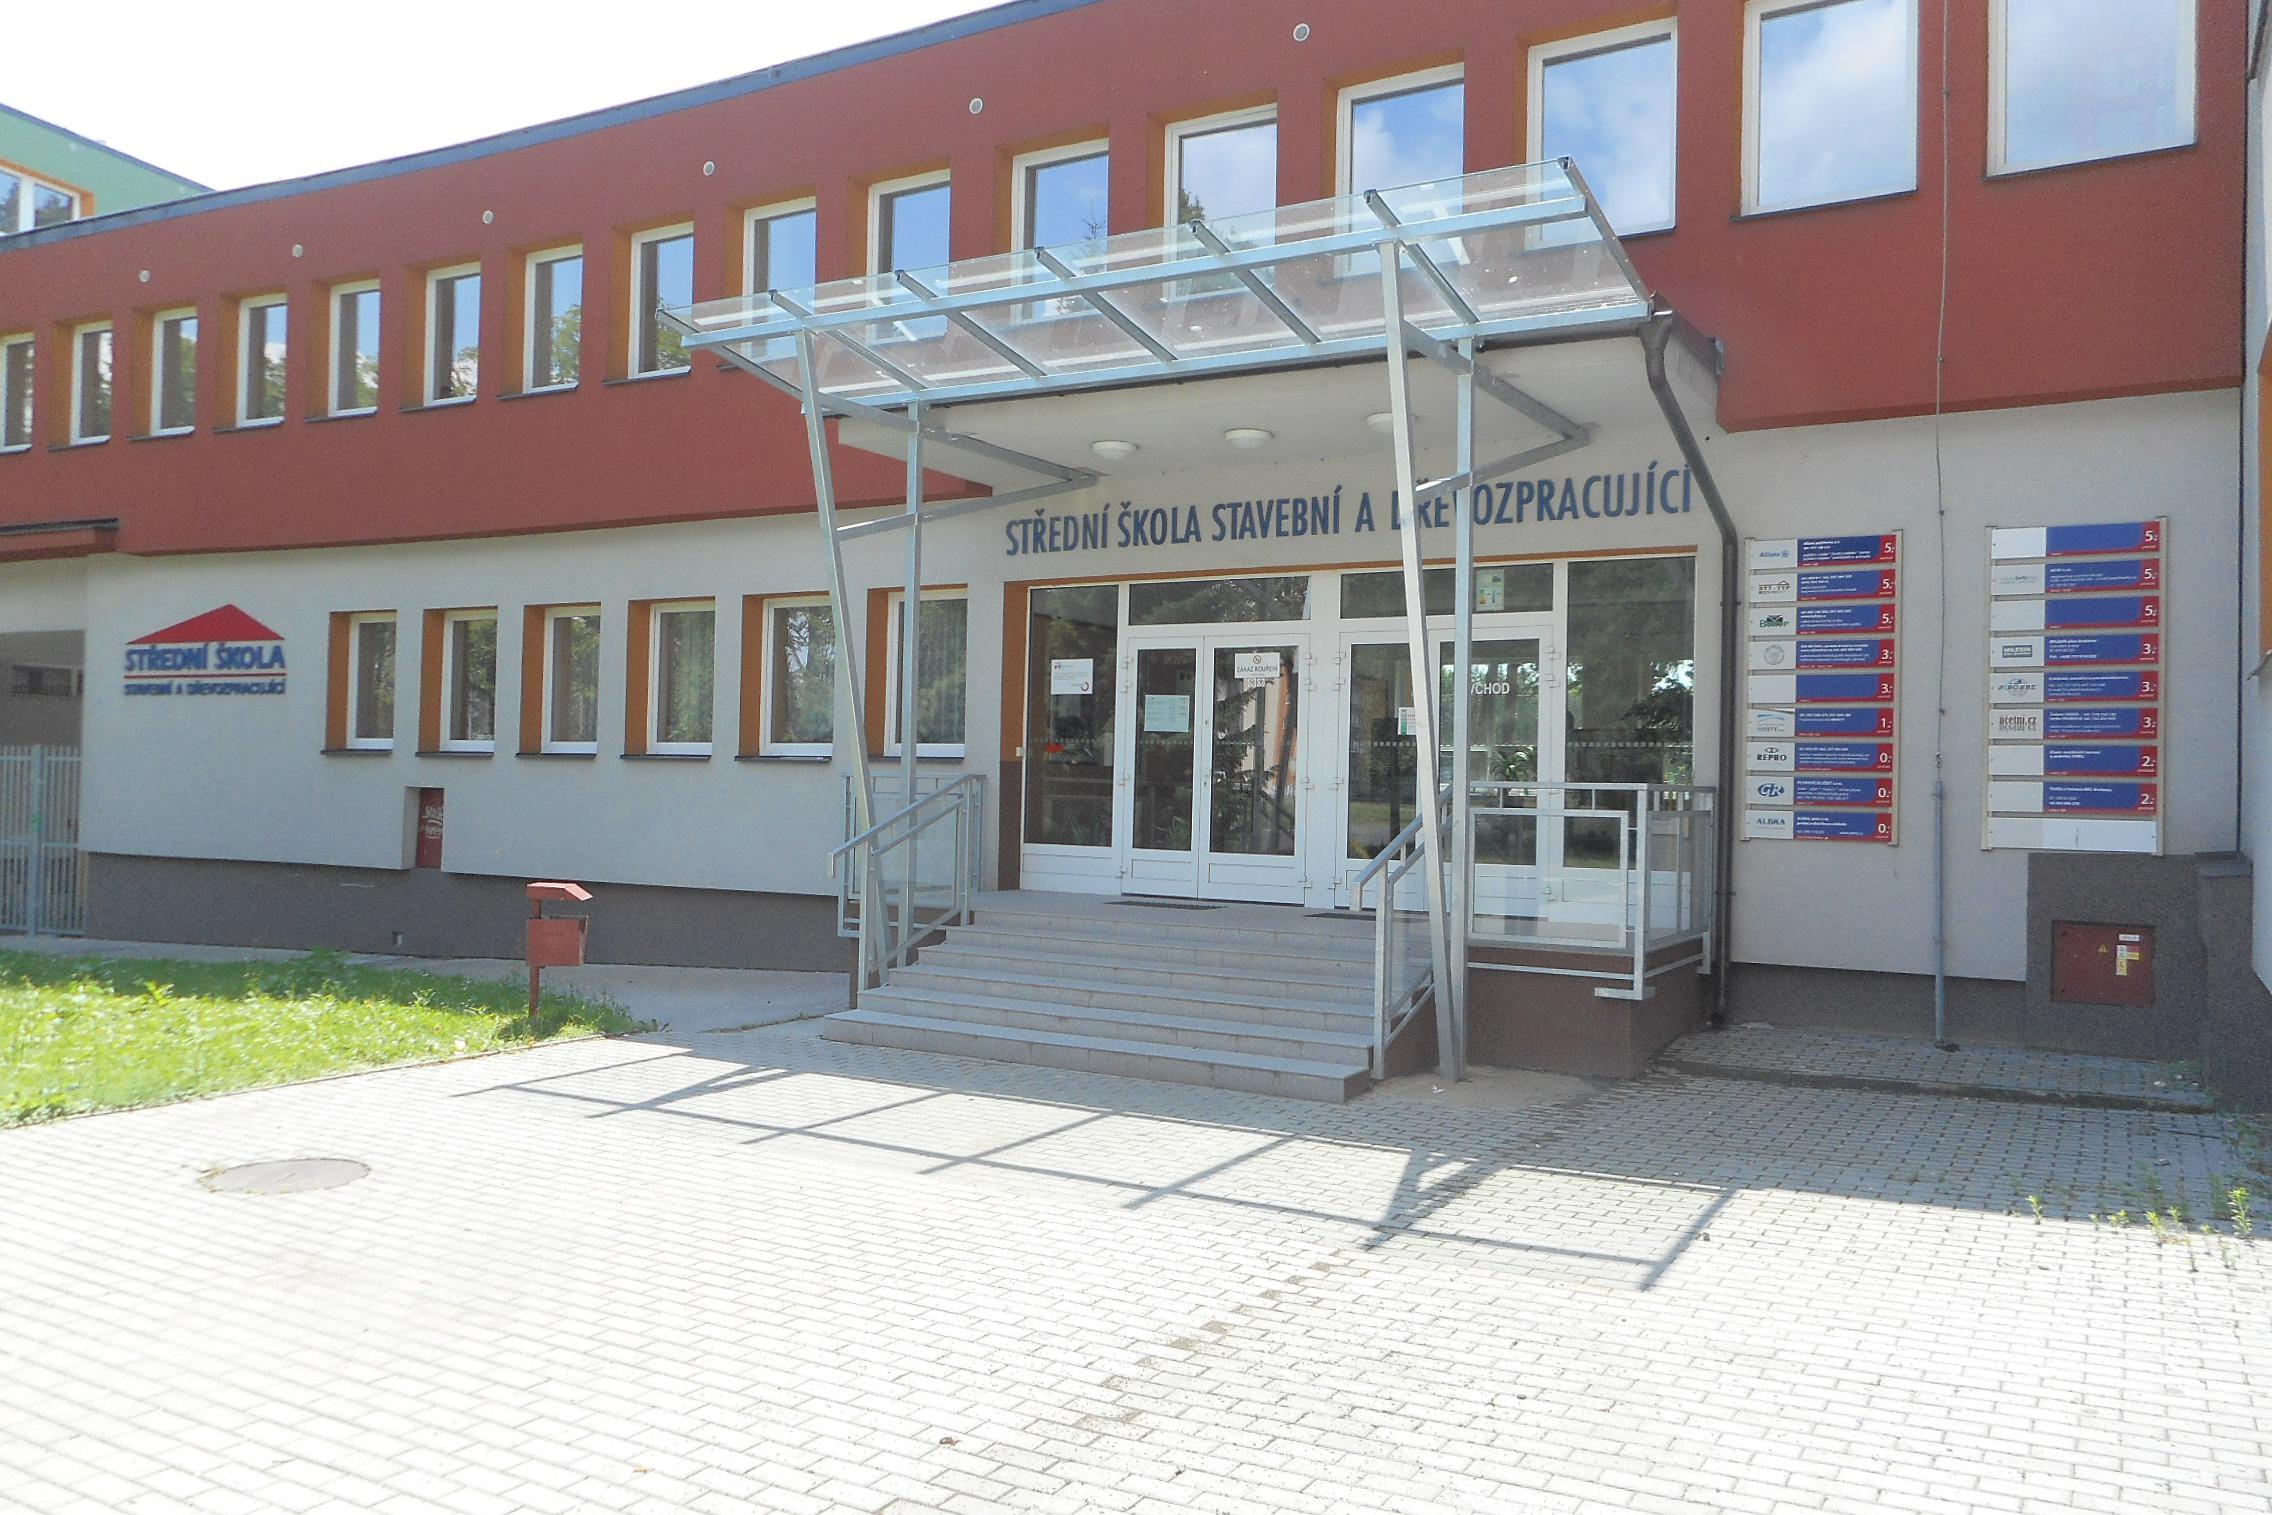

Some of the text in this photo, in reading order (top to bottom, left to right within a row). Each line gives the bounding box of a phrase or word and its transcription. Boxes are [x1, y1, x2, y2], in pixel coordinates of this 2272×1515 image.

[1006, 460, 1692, 556] STŘEDNÍ ŠKOLA STAVEBNÍ A ŘEOZPRACUJÍCÍ
[124, 642, 286, 671] STŘEDNÍ ŠKOLA
[1756, 753, 1788, 762] REPRO
